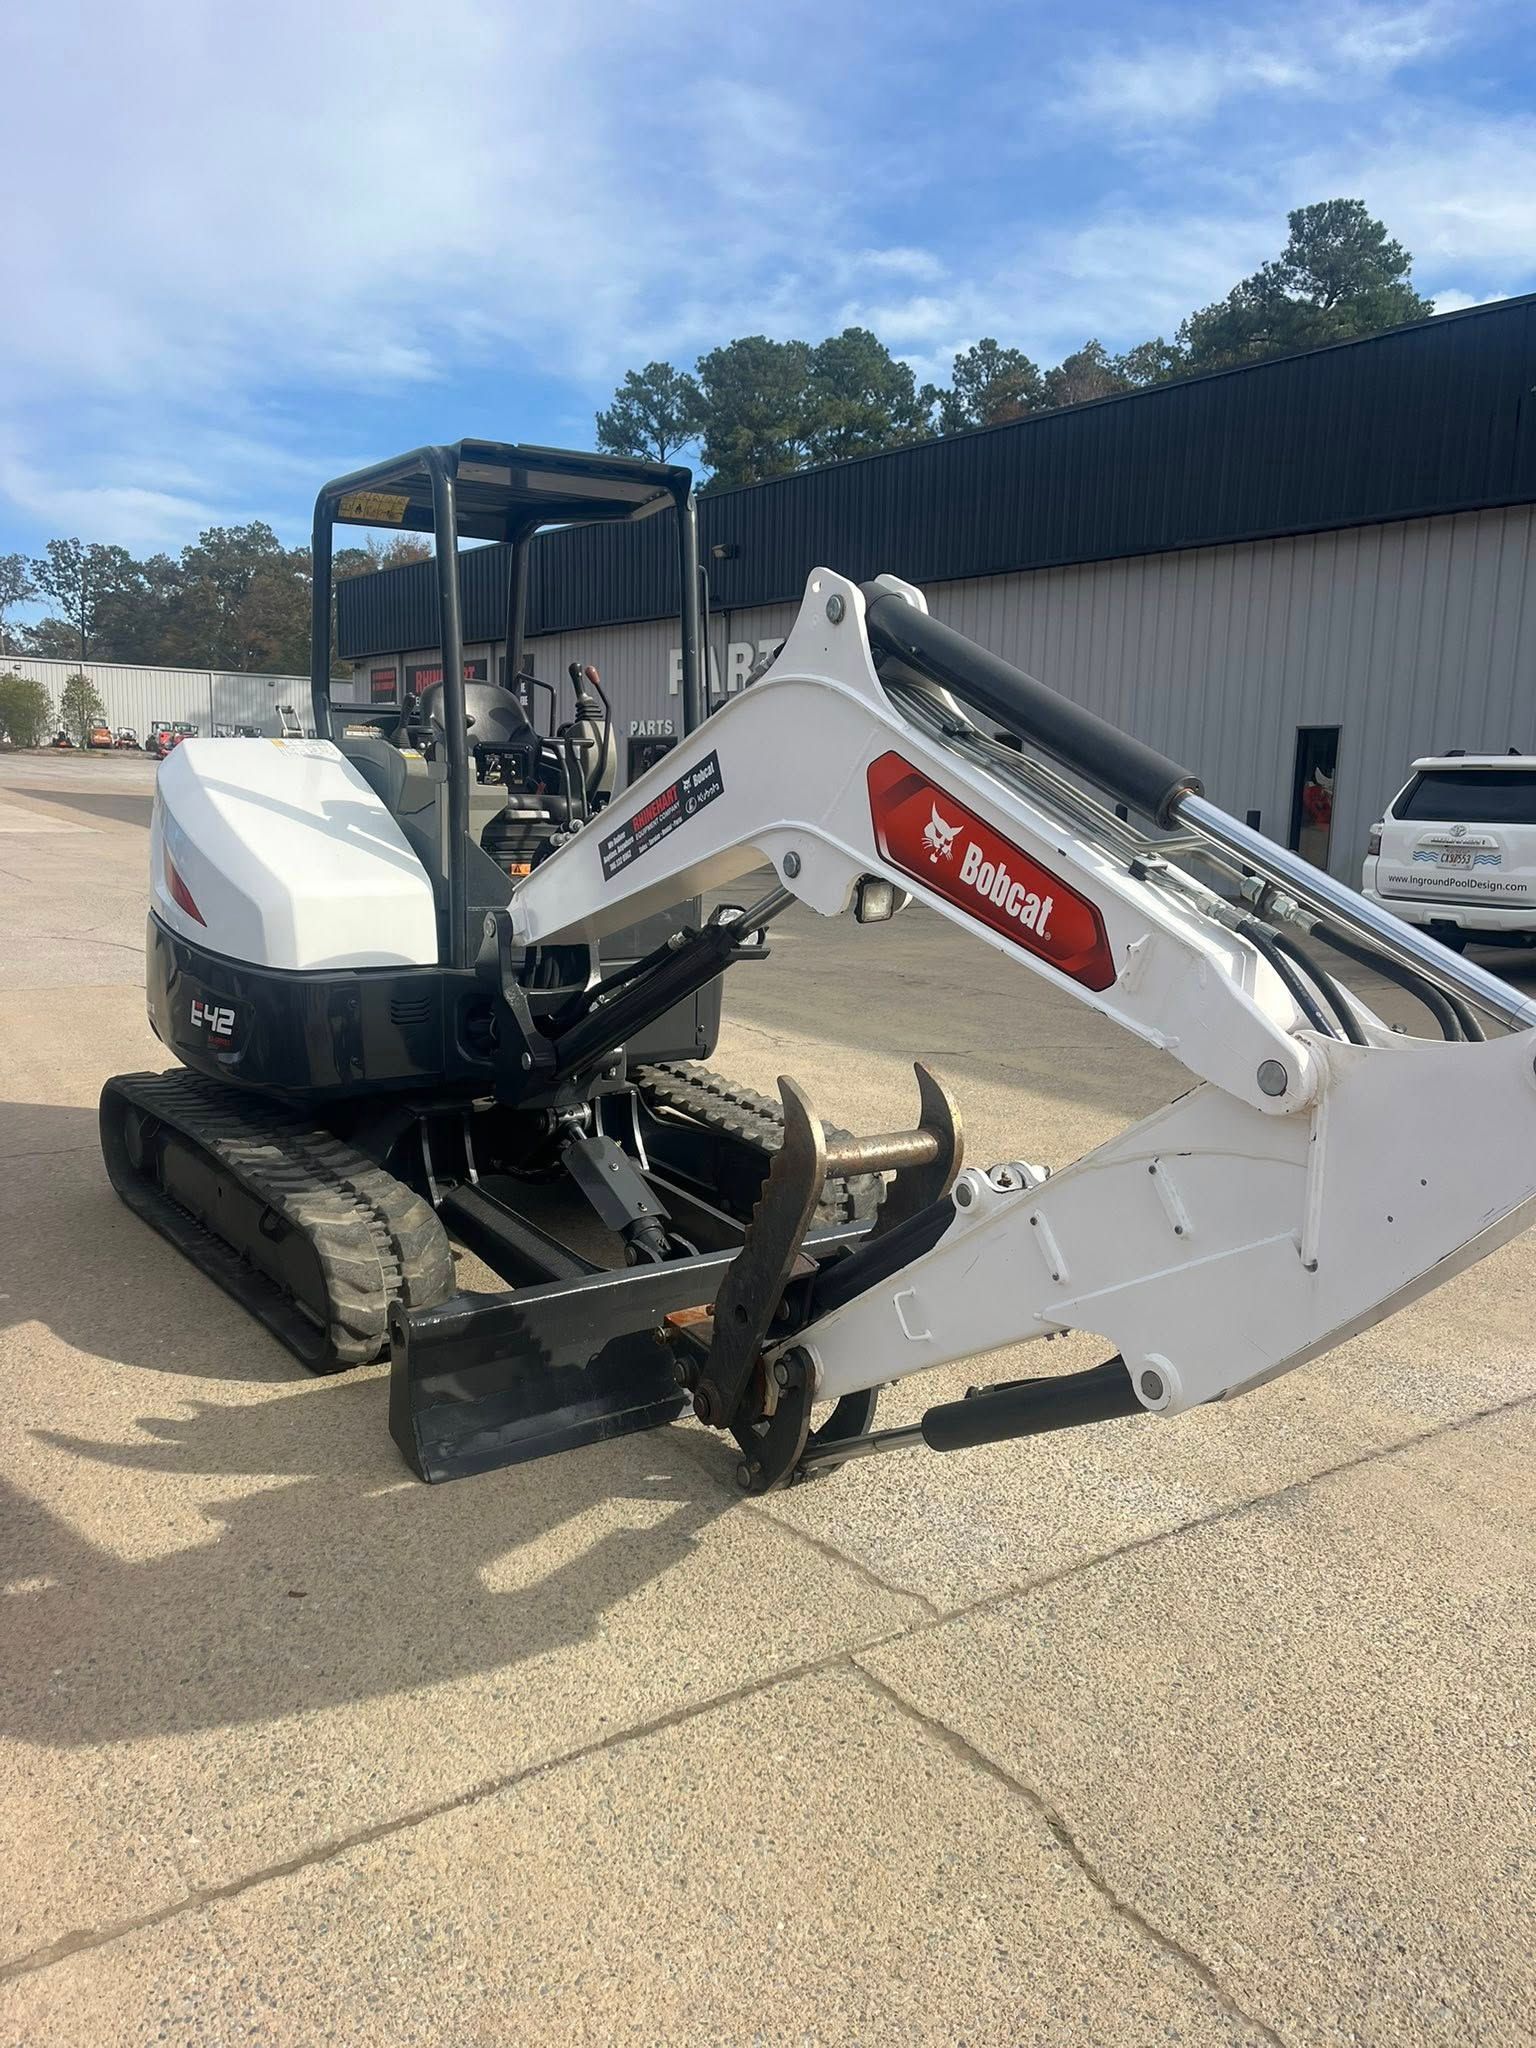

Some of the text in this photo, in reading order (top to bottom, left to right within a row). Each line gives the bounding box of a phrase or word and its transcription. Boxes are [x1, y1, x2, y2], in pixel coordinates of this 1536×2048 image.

[630, 719, 673, 736] PARTS
[692, 761, 715, 787] Bobcat
[697, 783, 720, 803] Kubota
[632, 784, 679, 832] RHINEHART
[659, 801, 681, 822] COMPANY
[959, 841, 1054, 938] Bobcat
[1388, 874, 1528, 893] www.IngroundPoolDesign.com
[190, 999, 236, 1036] E42
